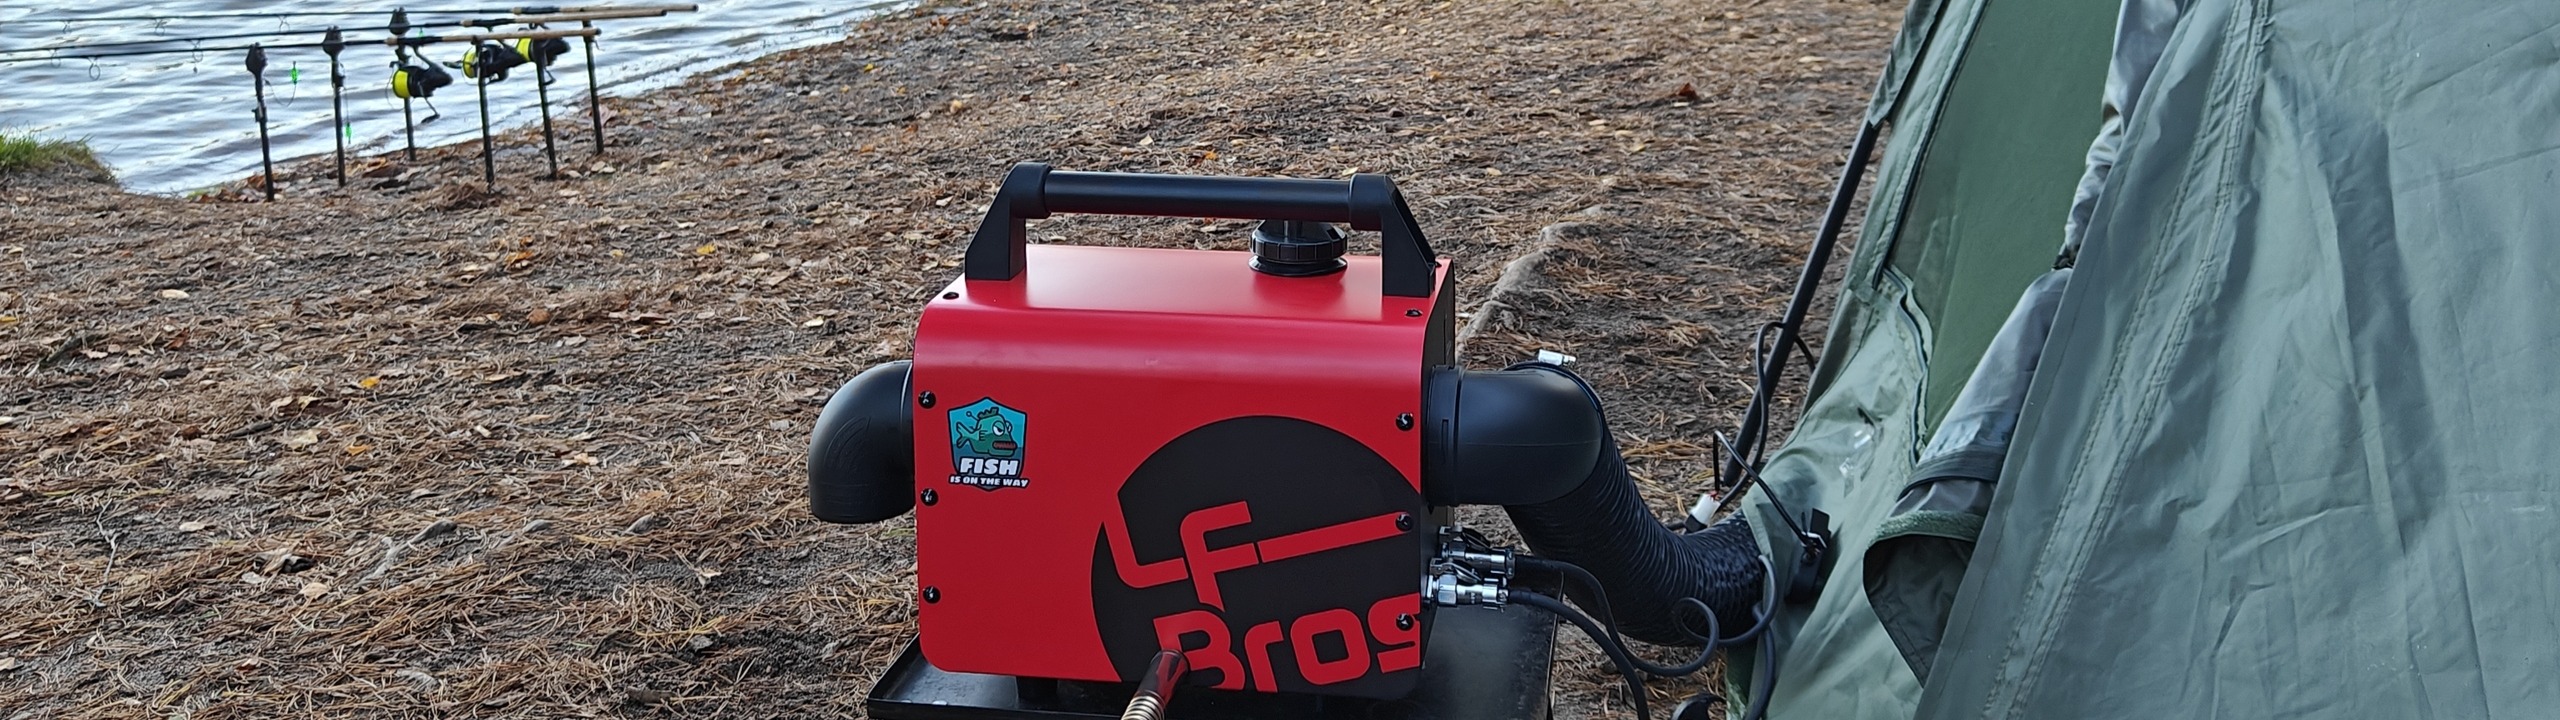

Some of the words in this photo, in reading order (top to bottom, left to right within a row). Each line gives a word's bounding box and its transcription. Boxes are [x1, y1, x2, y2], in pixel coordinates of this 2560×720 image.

[950, 475, 961, 483] IS
[962, 476, 978, 485] ON
[980, 477, 1001, 486] THE
[1002, 478, 1029, 487] WAY
[960, 457, 1019, 476] FISH
[1102, 492, 1259, 612] LF
[1152, 592, 1421, 693] Bros
